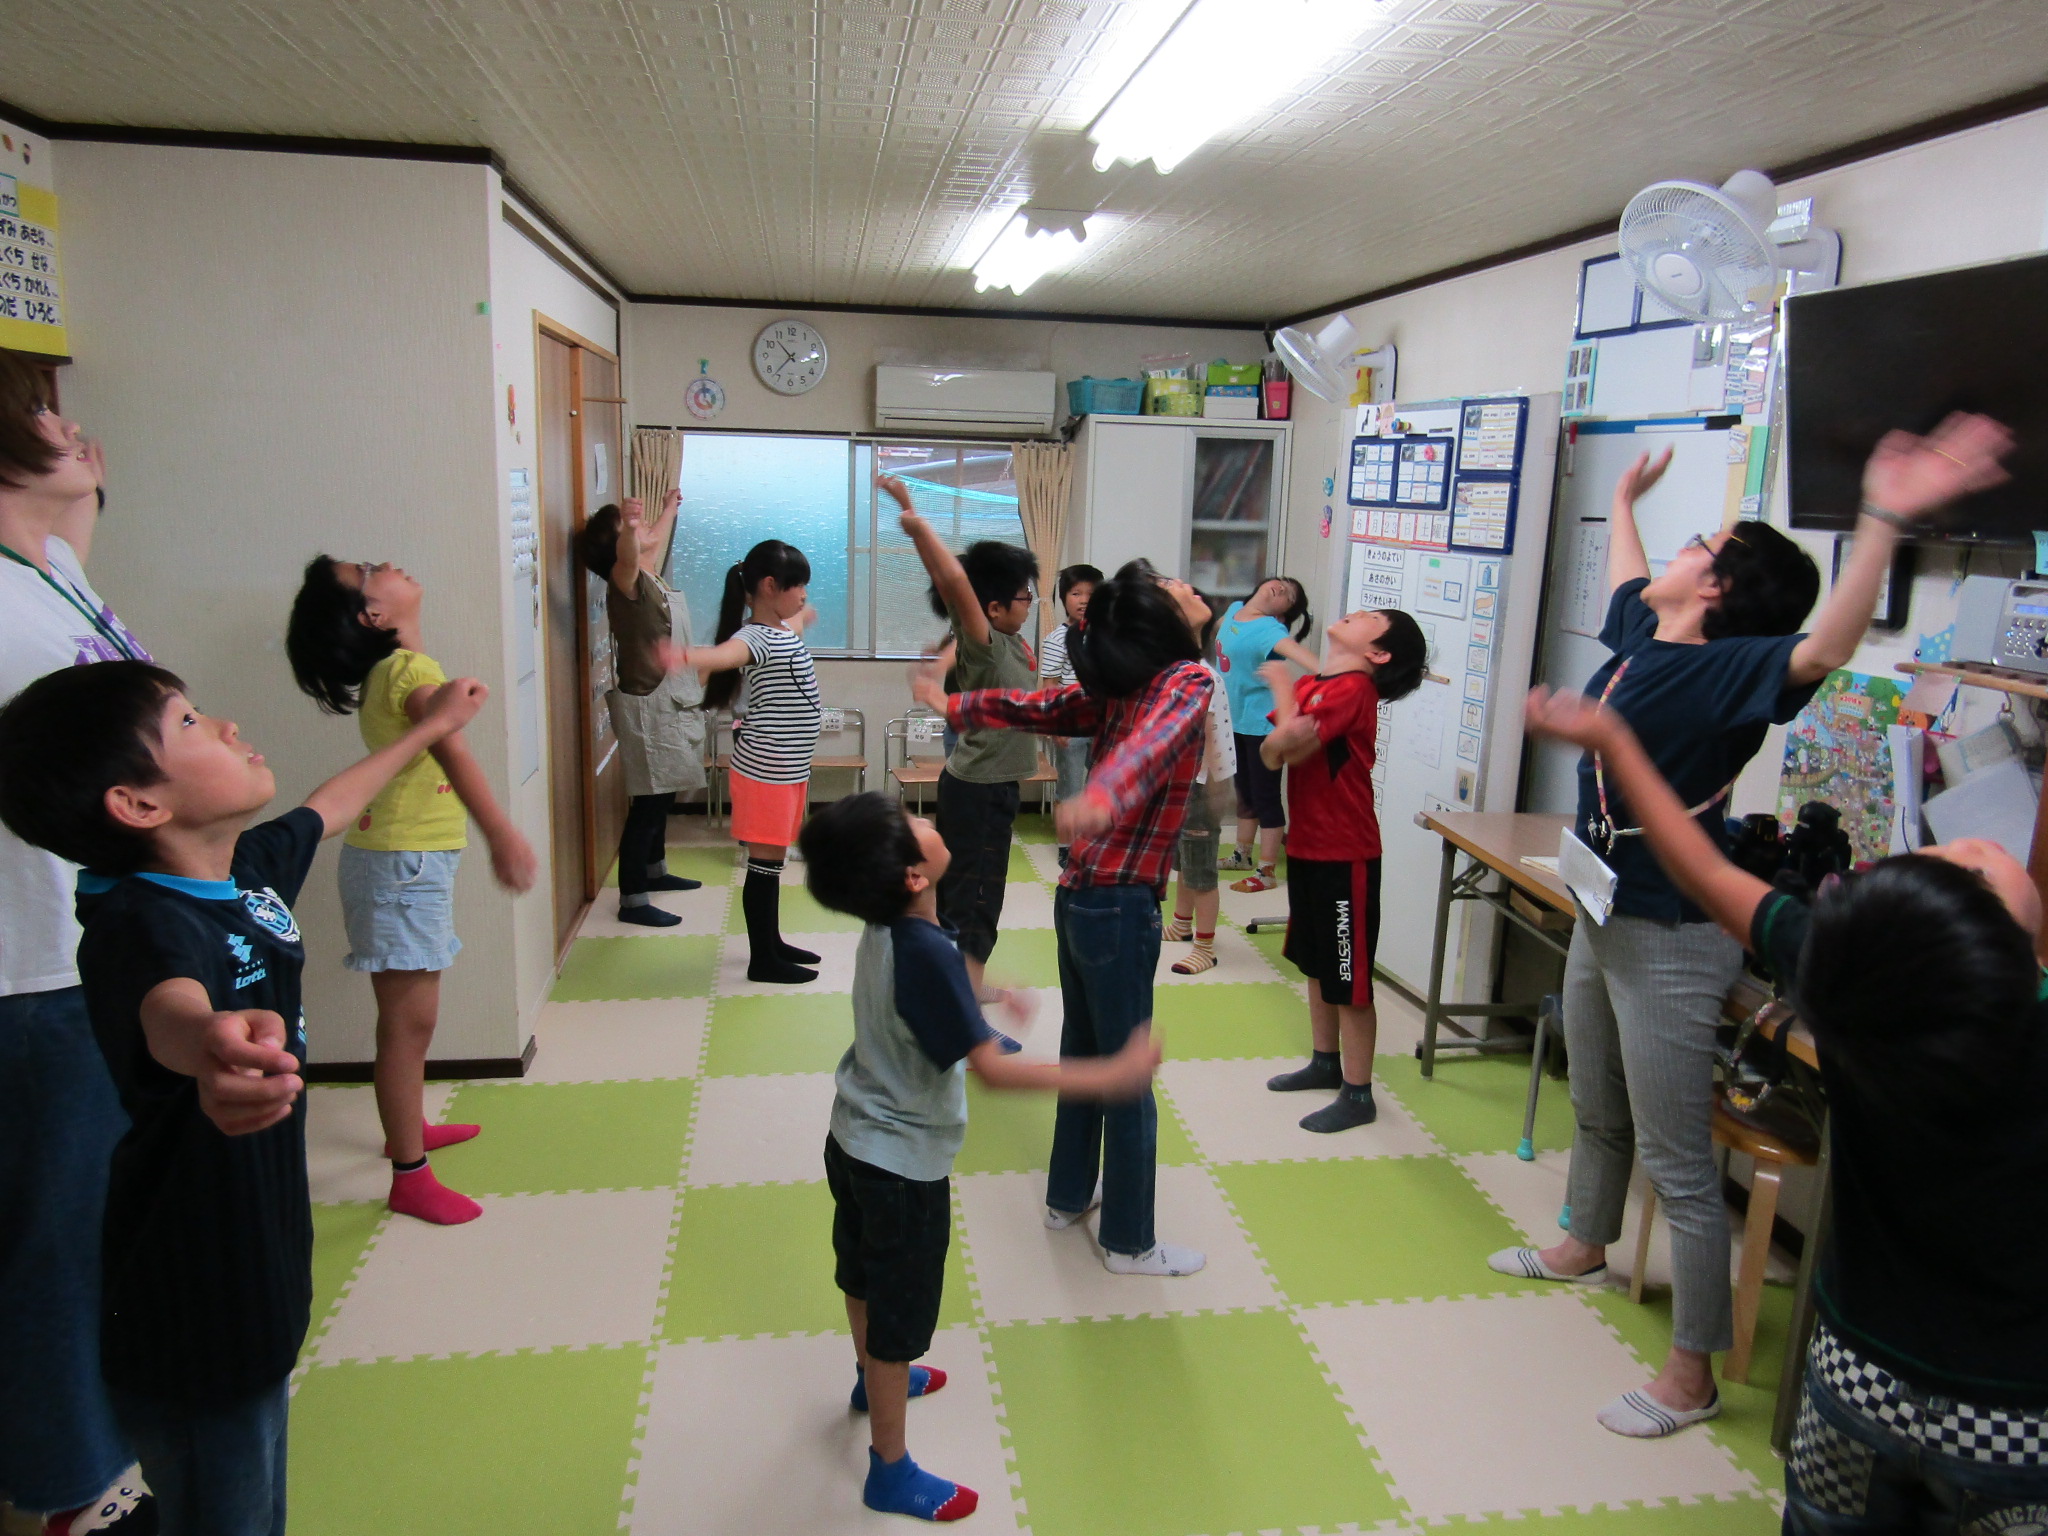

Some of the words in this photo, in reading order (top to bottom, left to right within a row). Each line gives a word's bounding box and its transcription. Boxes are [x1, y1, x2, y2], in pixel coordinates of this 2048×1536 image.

[0, 246, 24, 266] ぐち
[0, 271, 21, 291] ぐち
[775, 330, 783, 339] 11
[787, 327, 797, 337] 12
[766, 340, 775, 349] 10
[766, 365, 773, 373] 8
[808, 368, 815, 376] 4
[787, 379, 794, 387] 6
[800, 376, 806, 385] 5
[1335, 900, 1352, 982] MANCHESTER
